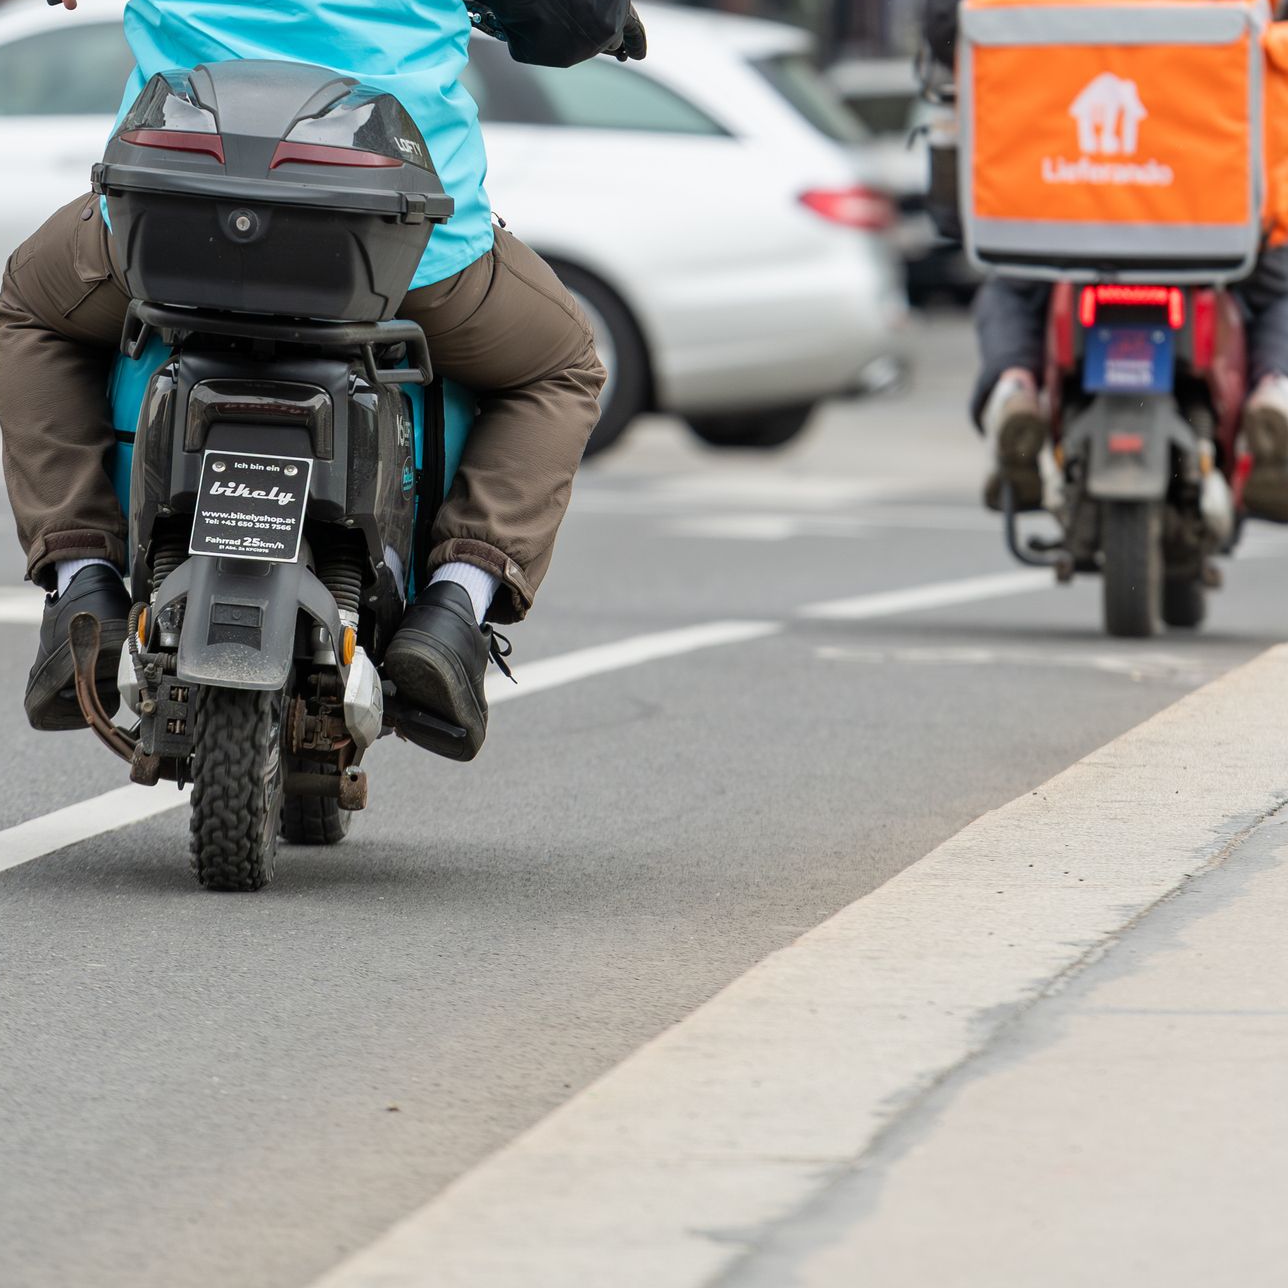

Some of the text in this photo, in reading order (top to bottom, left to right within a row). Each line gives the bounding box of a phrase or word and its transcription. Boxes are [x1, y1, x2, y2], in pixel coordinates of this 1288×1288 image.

[394, 136, 422, 157] LOFTY
[1041, 156, 1174, 186] Lieferando
[234, 462, 280, 472] Ich bin ein
[209, 481, 295, 505] bikely
[201, 510, 296, 524] www.bikelyshop.at
[237, 520, 253, 528] 650
[271, 523, 292, 531] 7566
[205, 536, 285, 549] Fahrrad 25km/h
